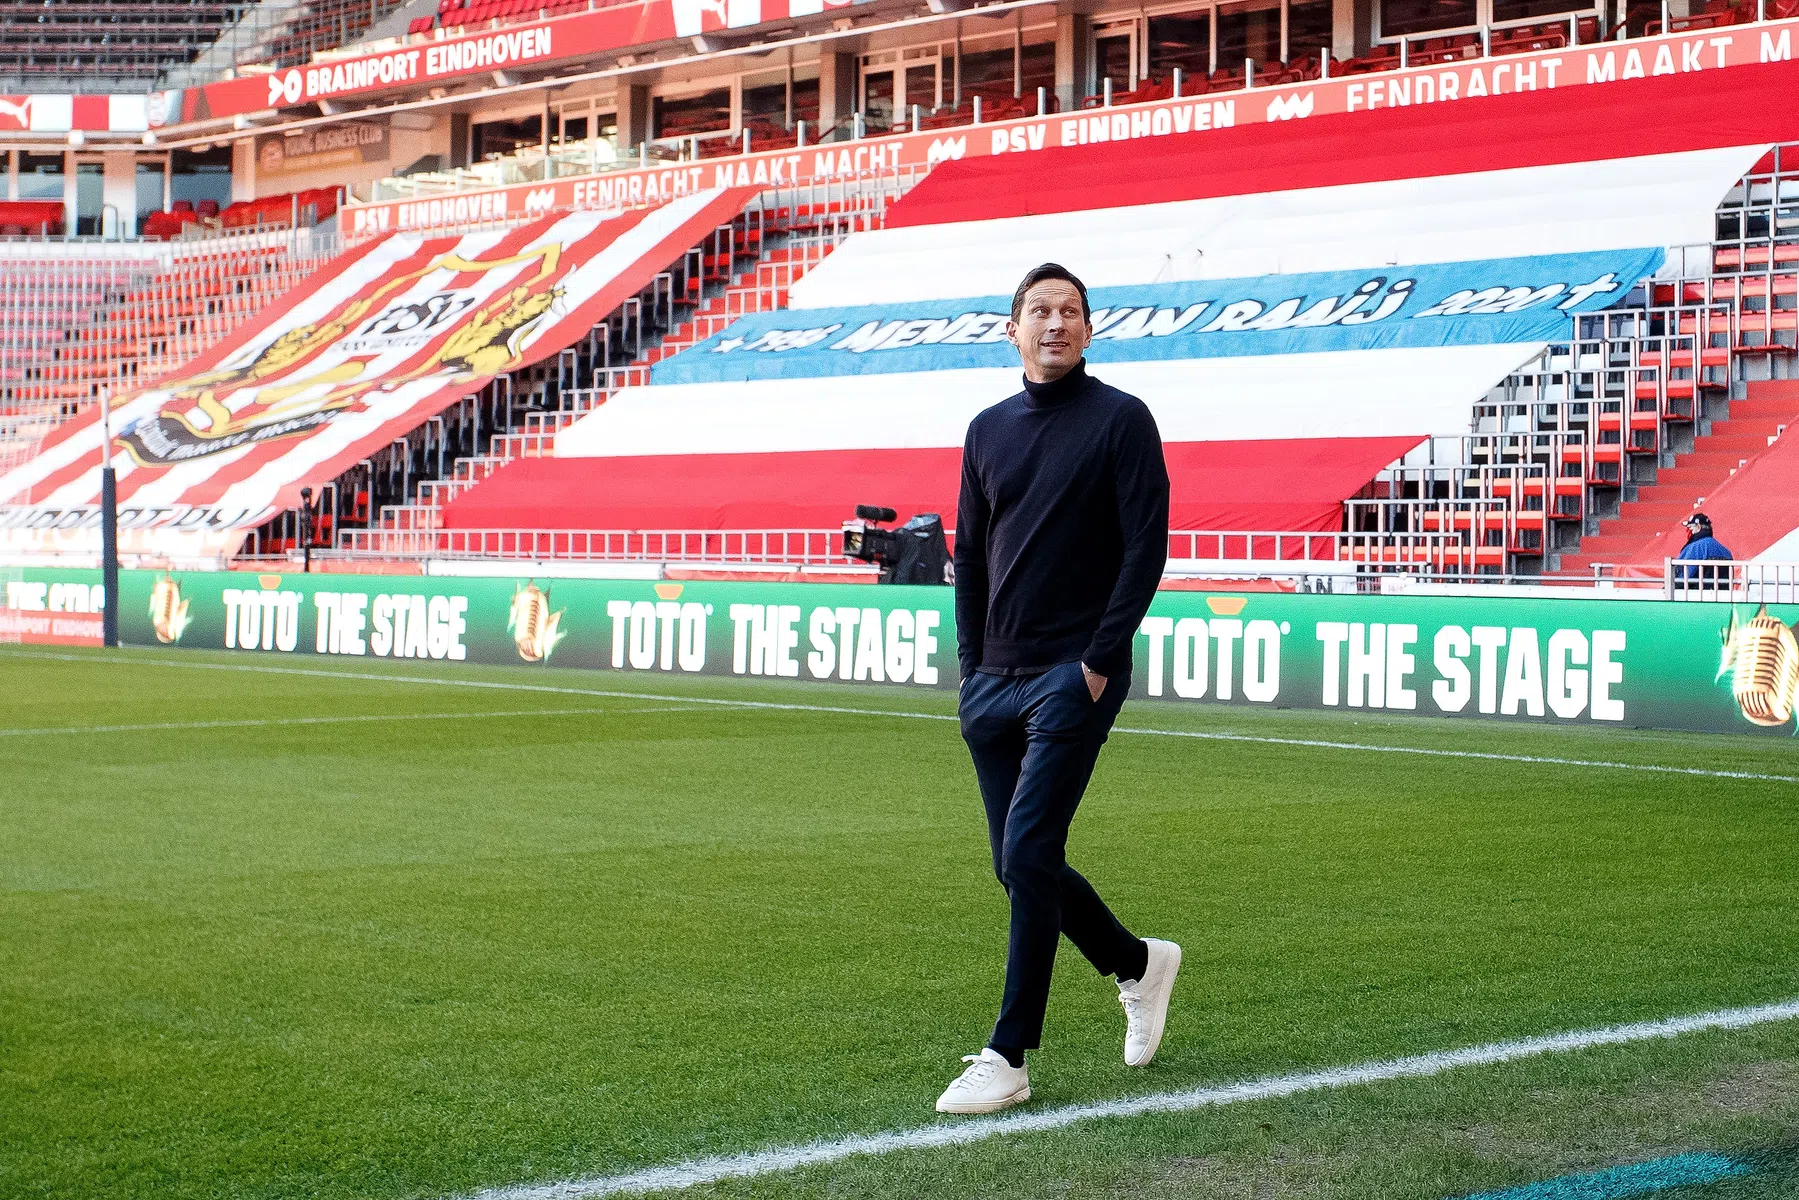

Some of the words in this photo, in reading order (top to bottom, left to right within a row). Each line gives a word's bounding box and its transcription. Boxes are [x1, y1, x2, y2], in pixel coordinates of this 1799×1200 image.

[305, 50, 420, 97] BRAINPORT
[426, 26, 551, 76] EINDHOVEN
[1586, 36, 1733, 84] MAAKT
[990, 123, 1047, 155] PSV
[1061, 99, 1236, 147] EINDHOVEN
[714, 155, 802, 189] MAAKT
[814, 142, 904, 178] MACHT
[354, 206, 391, 232] PSV
[398, 191, 507, 227] EINDHOVEN
[1090, 301, 1216, 341] VAN
[223, 589, 301, 652] TOTO
[314, 591, 368, 656] THE
[371, 593, 468, 661] STAGE
[606, 600, 708, 672] TOTO
[729, 604, 801, 678] THE
[807, 606, 941, 685] STAGE
[1139, 616, 1282, 702] TOTO
[1316, 621, 1418, 710] THE
[1432, 624, 1626, 721] STAGE
